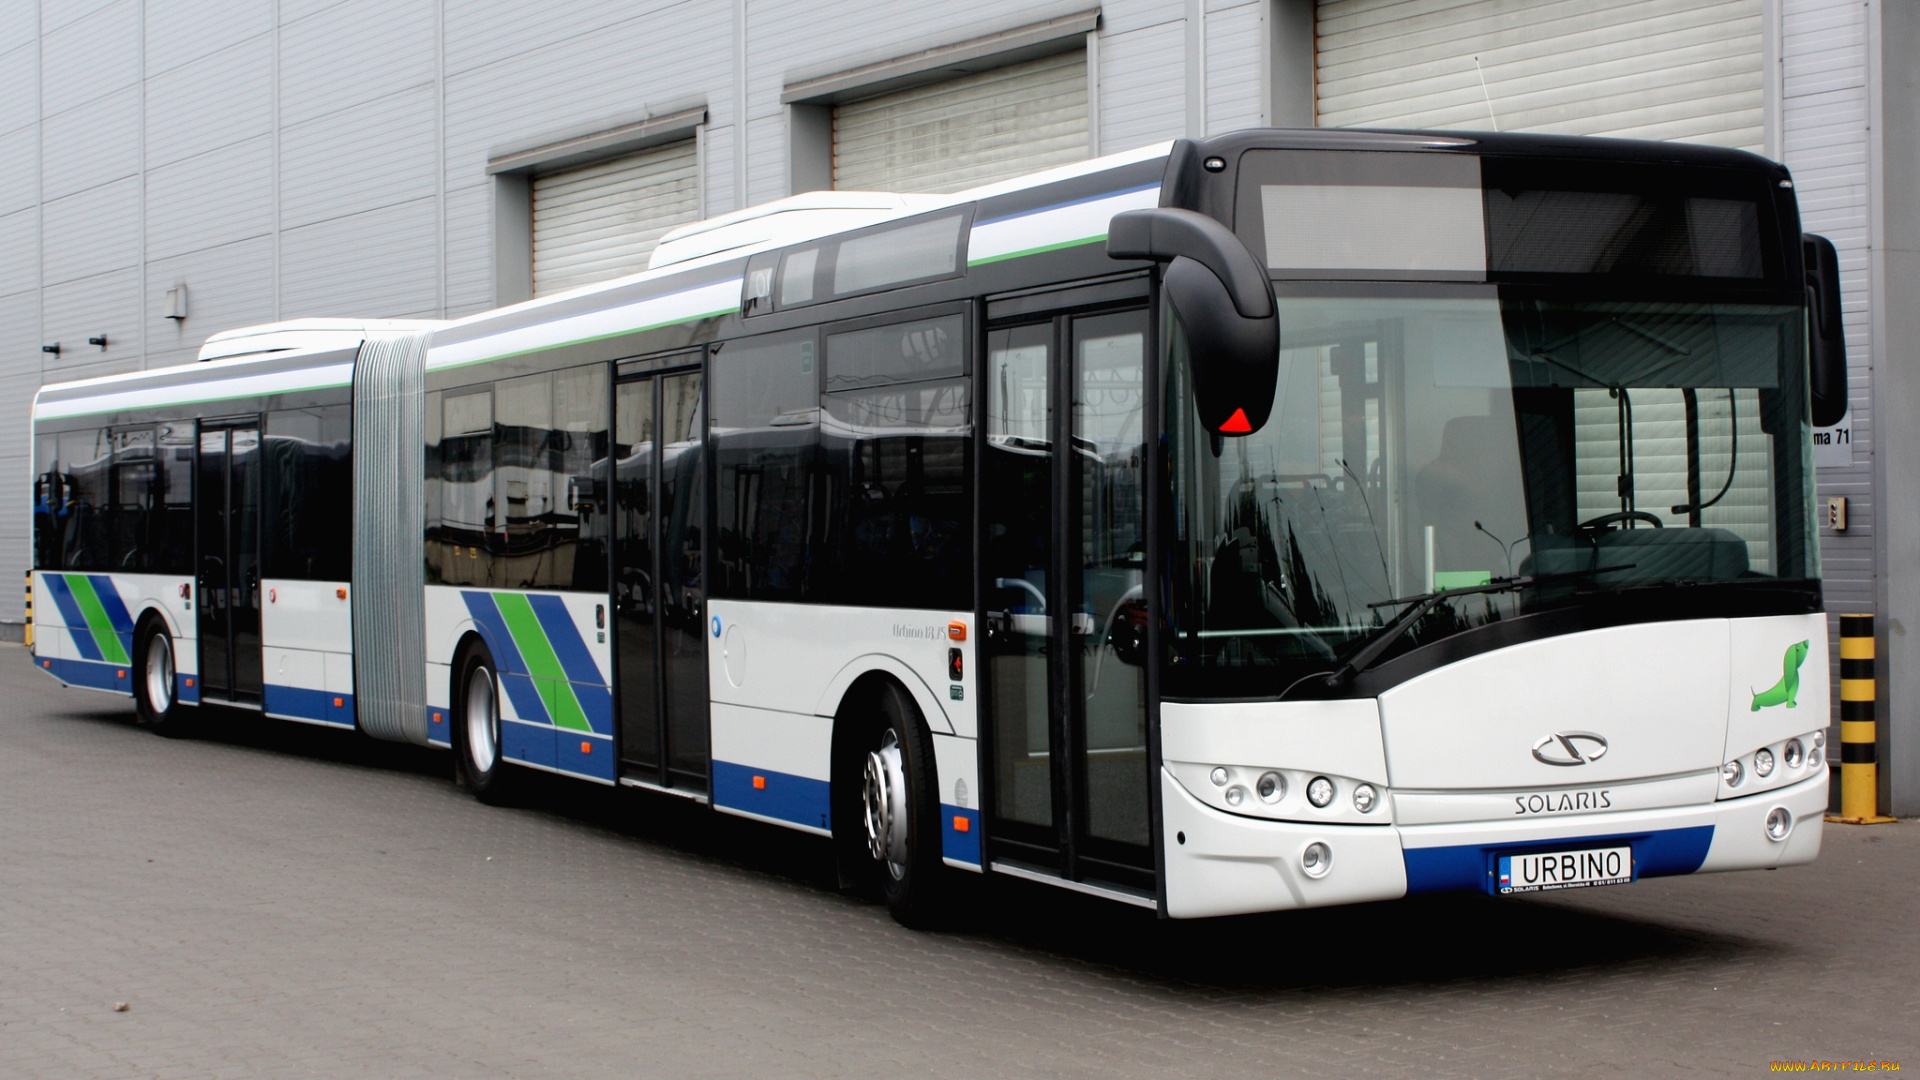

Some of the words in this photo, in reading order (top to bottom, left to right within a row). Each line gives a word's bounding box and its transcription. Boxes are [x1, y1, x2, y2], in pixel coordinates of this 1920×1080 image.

[1836, 428, 1849, 444] 71
[893, 624, 924, 639] Urbino
[1515, 790, 1611, 815] SOLARIS
[1523, 851, 1621, 883] URBINO
[1513, 885, 1539, 893] SOLARIS
